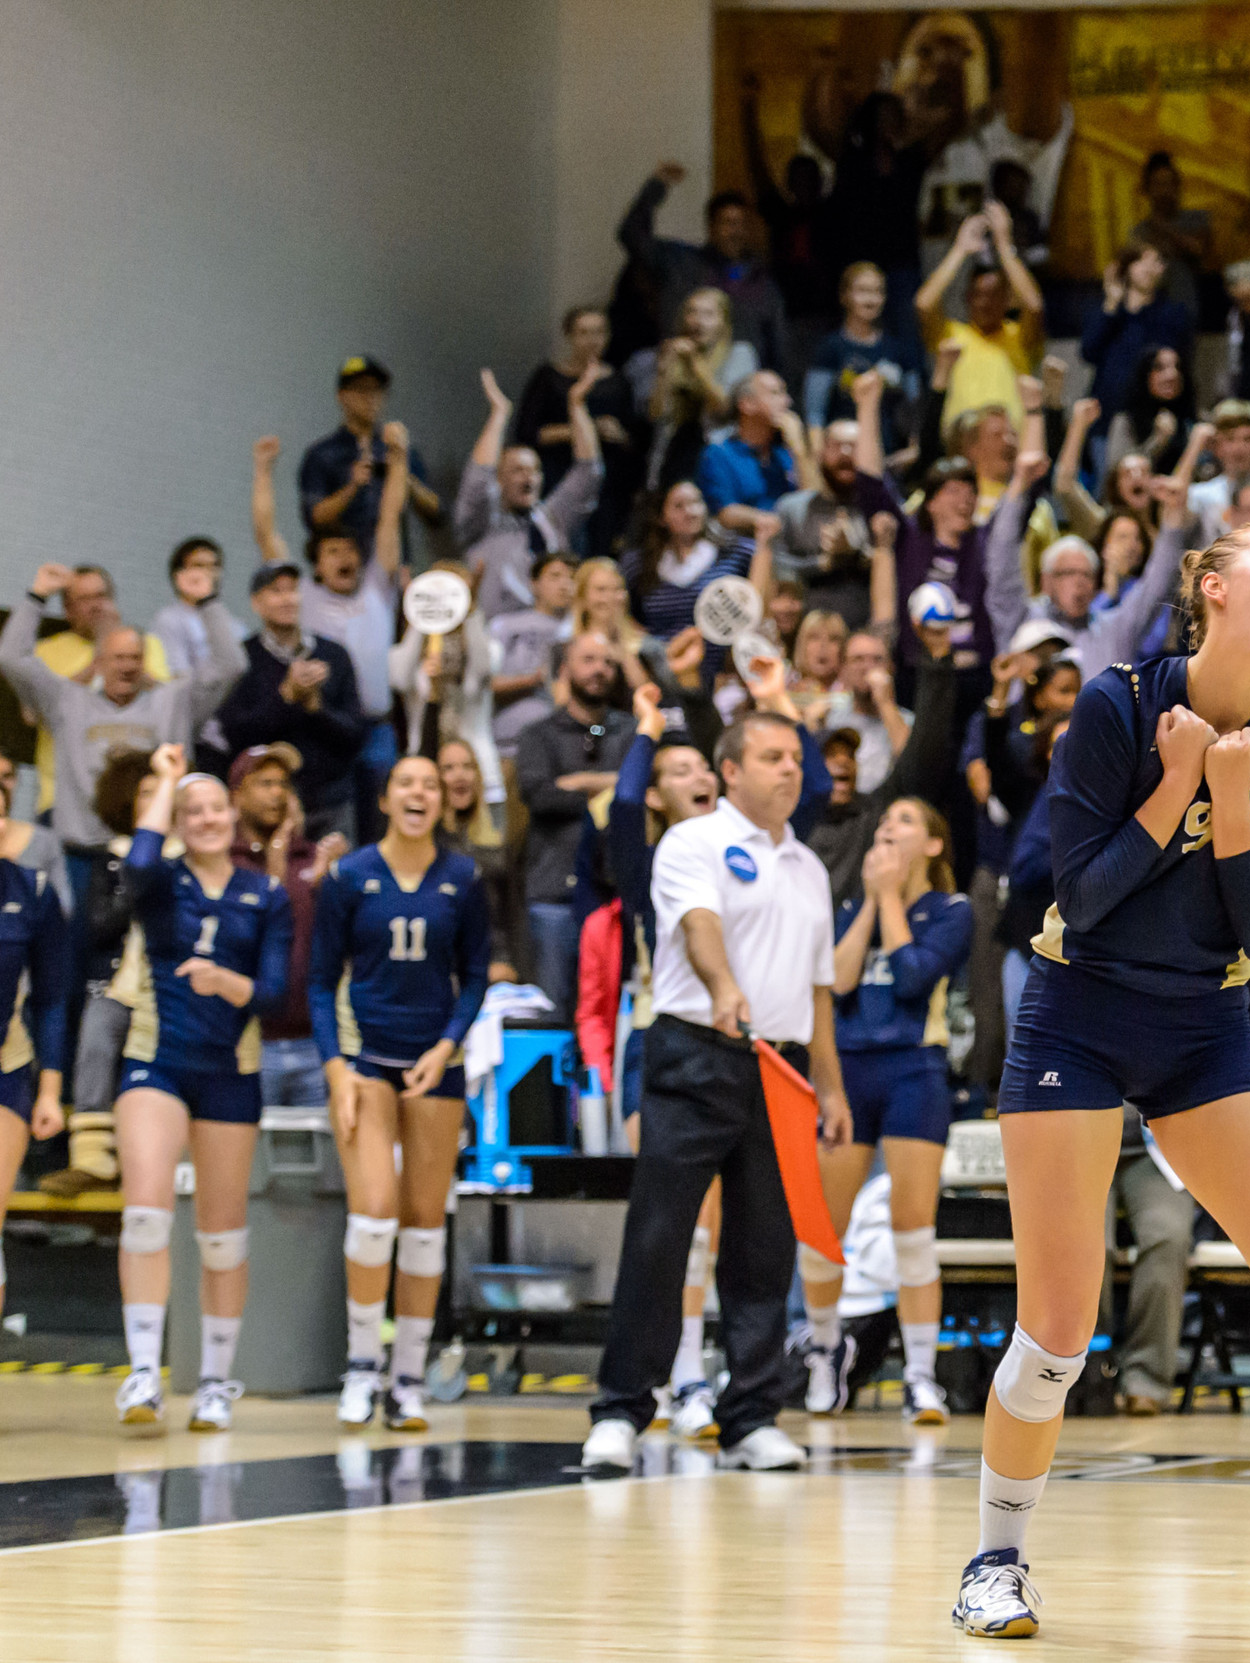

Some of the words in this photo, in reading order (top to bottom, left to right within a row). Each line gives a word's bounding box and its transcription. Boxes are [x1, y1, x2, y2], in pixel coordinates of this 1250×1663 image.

[1181, 800, 1213, 854] 9
[193, 915, 219, 956] 1
[388, 916, 428, 961] 11
